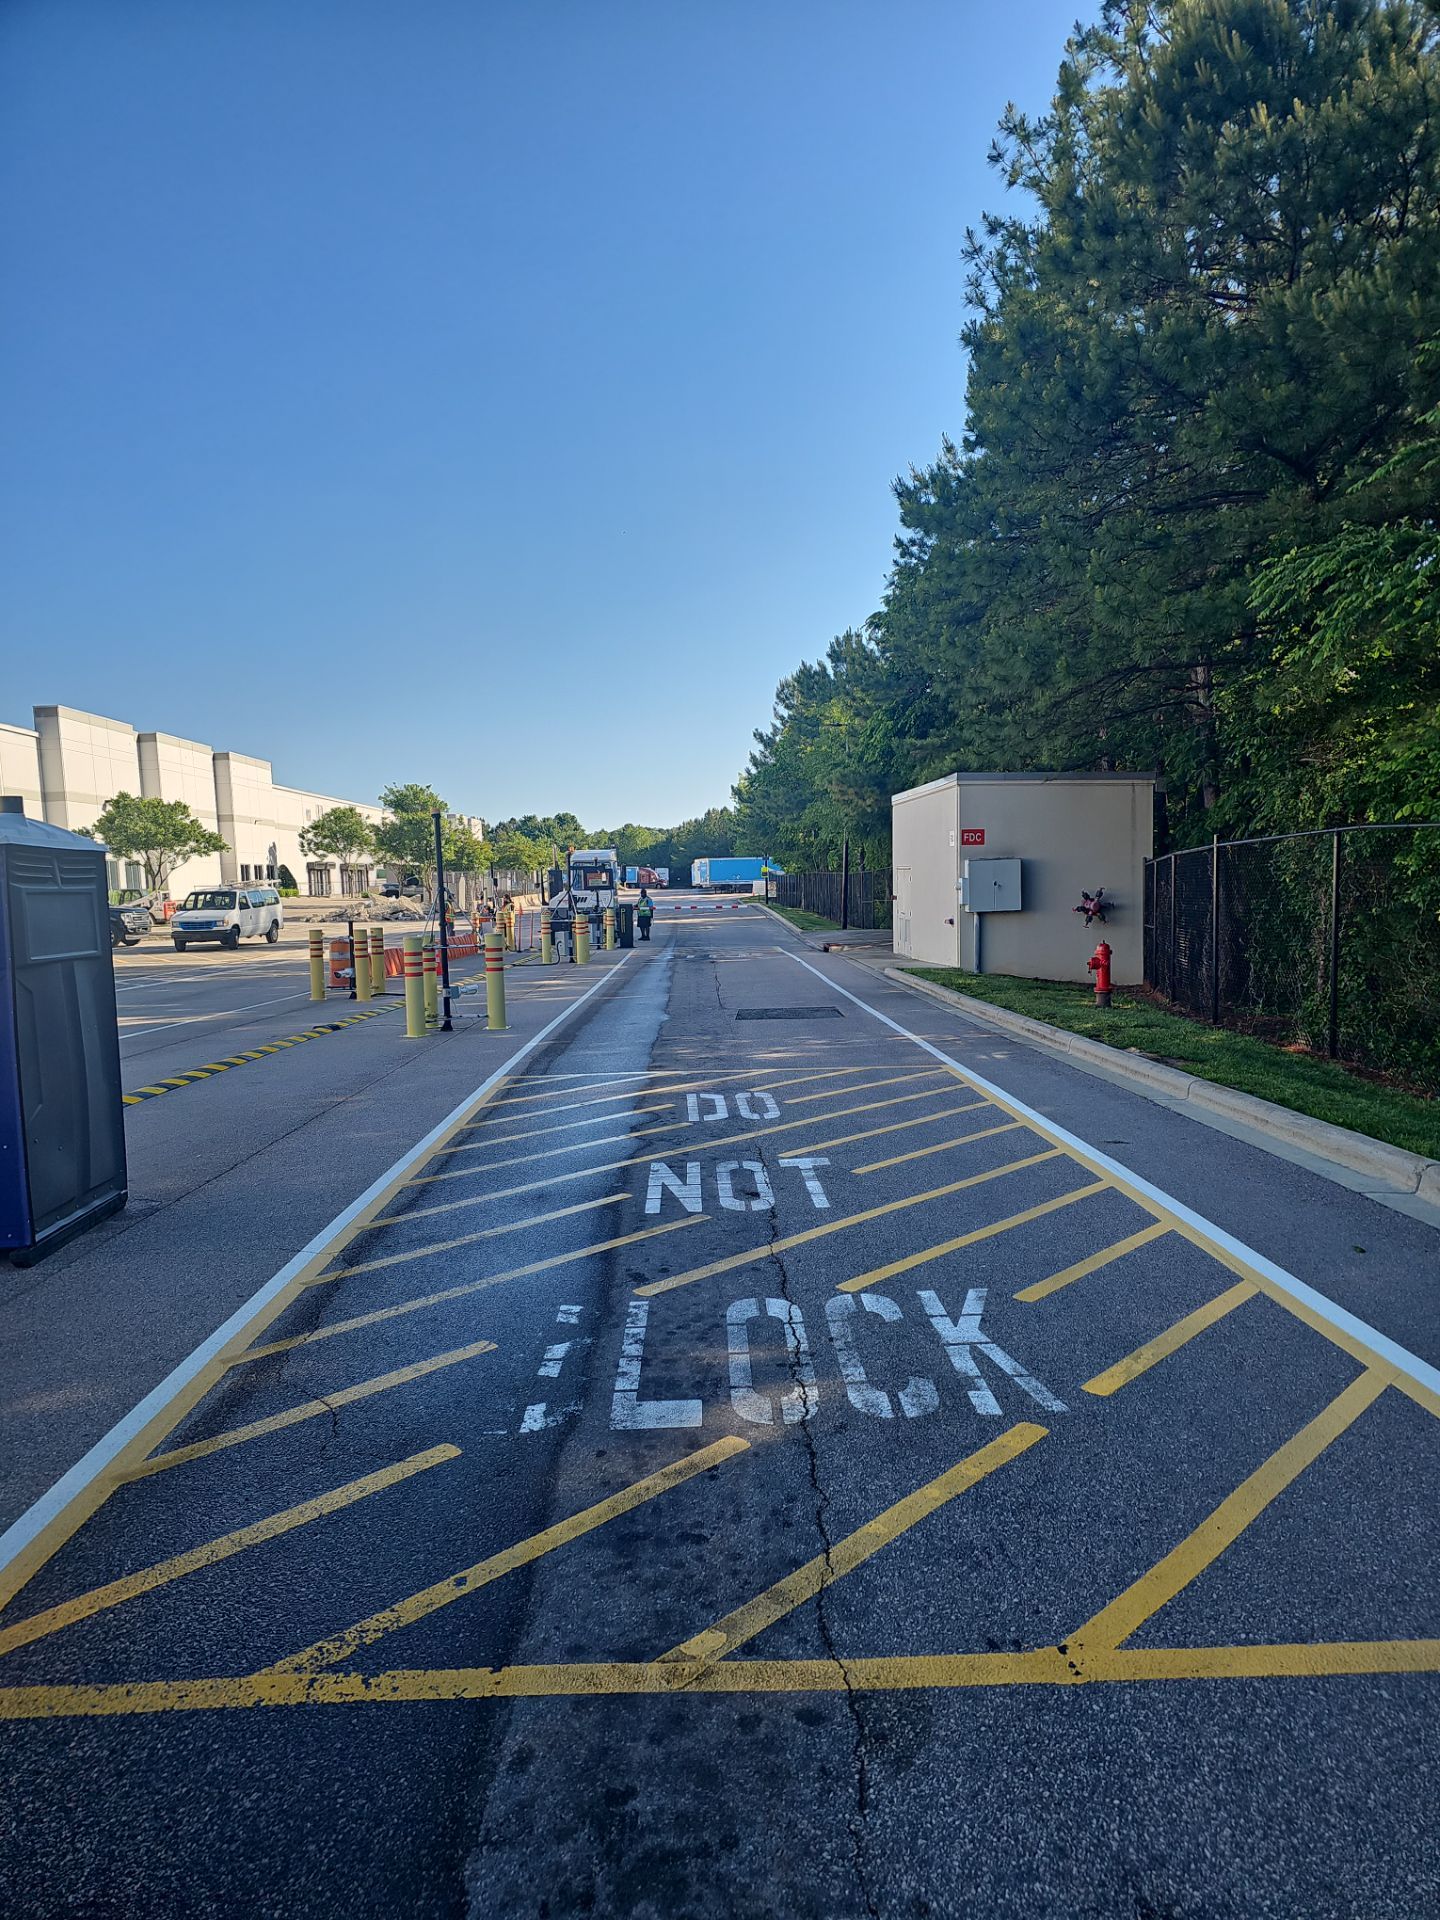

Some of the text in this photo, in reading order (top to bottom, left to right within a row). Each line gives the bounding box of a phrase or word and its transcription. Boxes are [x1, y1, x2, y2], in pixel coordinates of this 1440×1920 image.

[963, 832, 982, 842] FDC
[686, 1092, 781, 1122] DO
[645, 1157, 831, 1214] NOT
